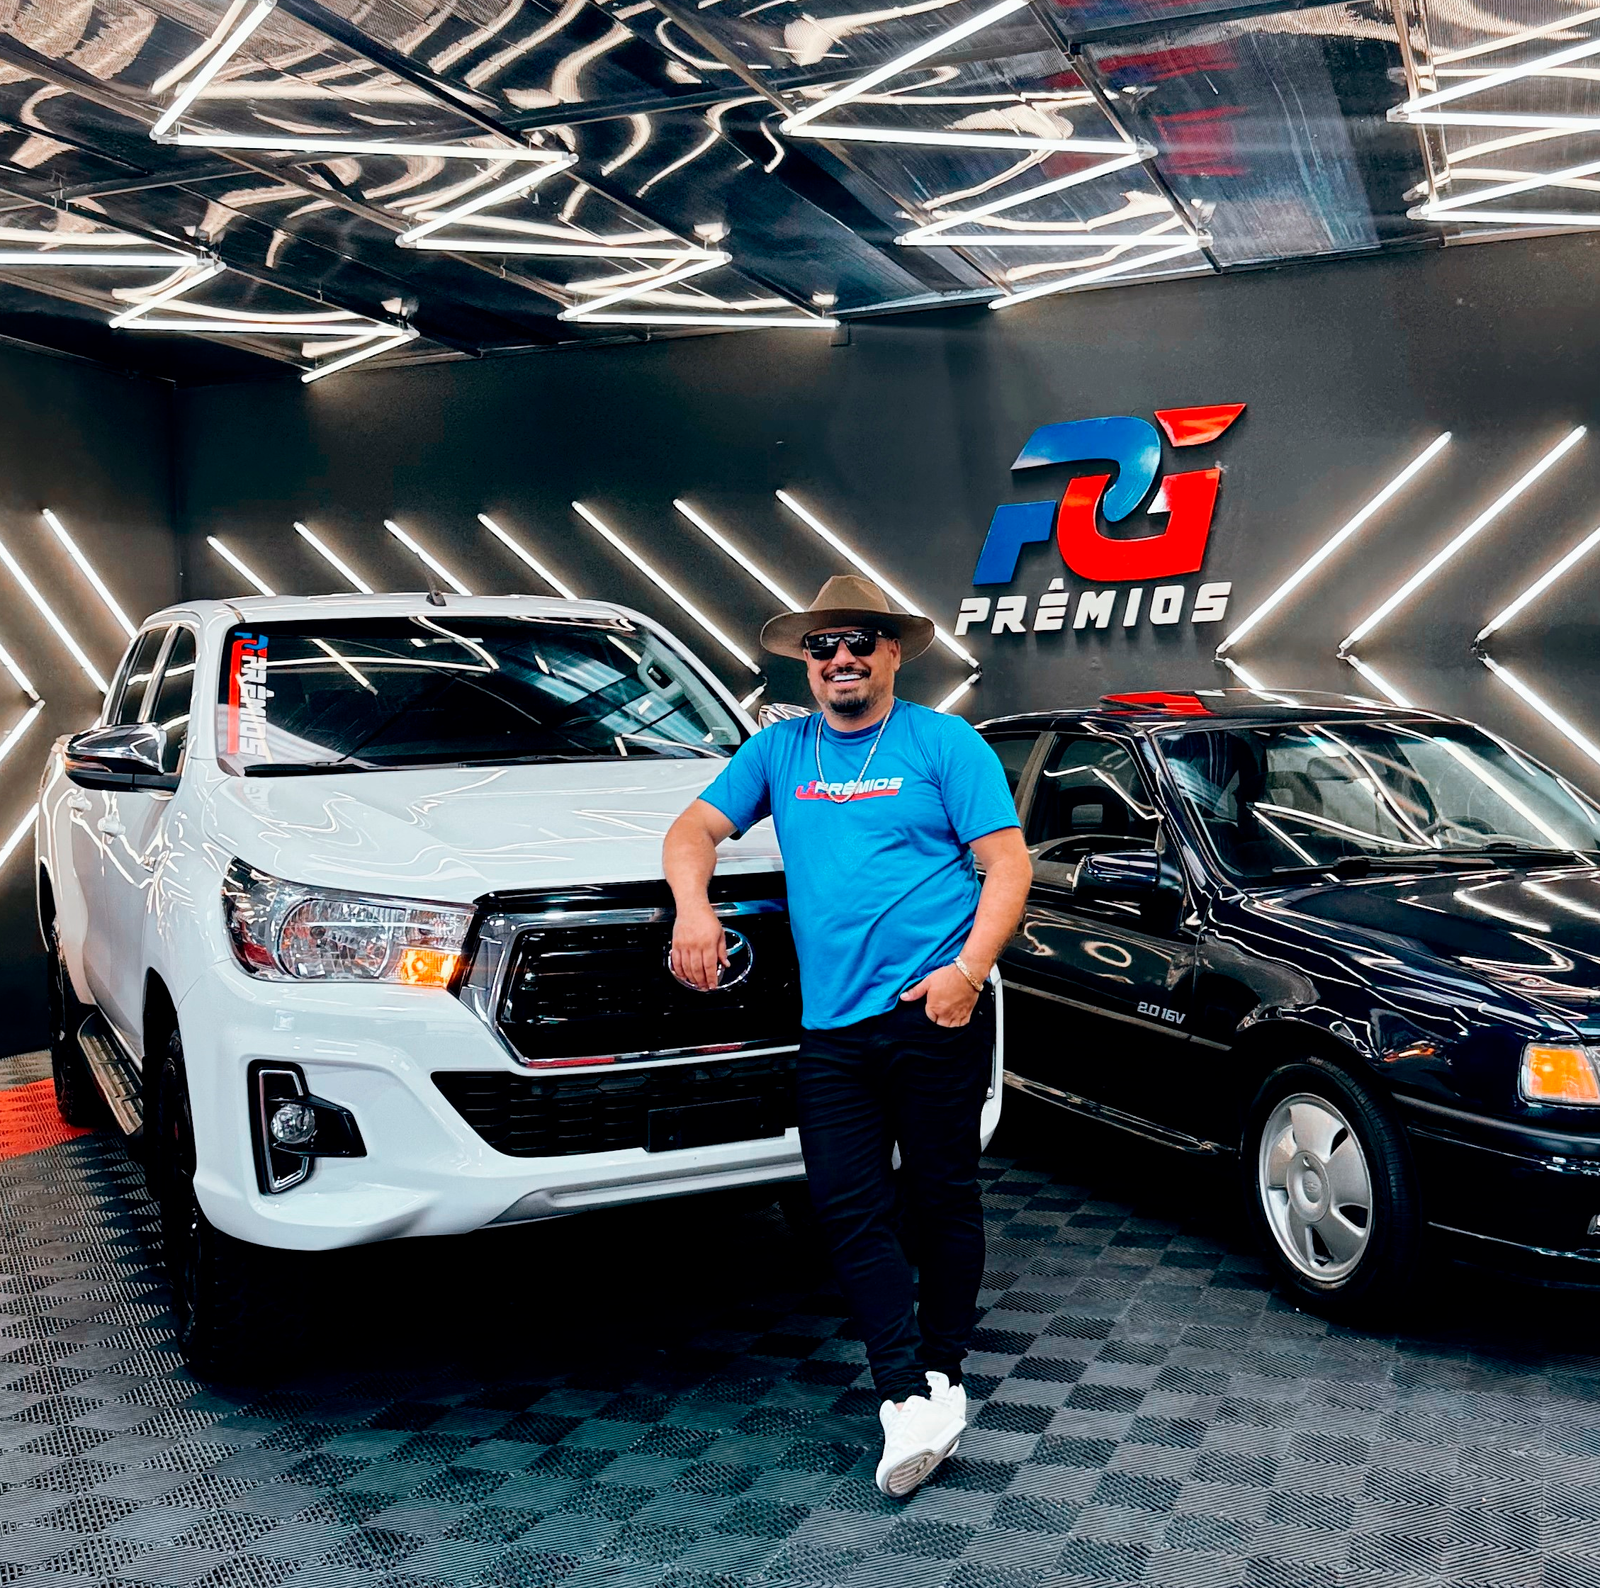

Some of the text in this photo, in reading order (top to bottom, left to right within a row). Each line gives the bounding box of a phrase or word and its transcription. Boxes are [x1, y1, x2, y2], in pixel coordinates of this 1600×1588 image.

[954, 578, 1232, 636] PRÊMIOS
[239, 655, 275, 758] PRÊMIOS
[814, 777, 904, 796] PRÊMIOS
[1137, 1001, 1186, 1024] 2.0 16V
